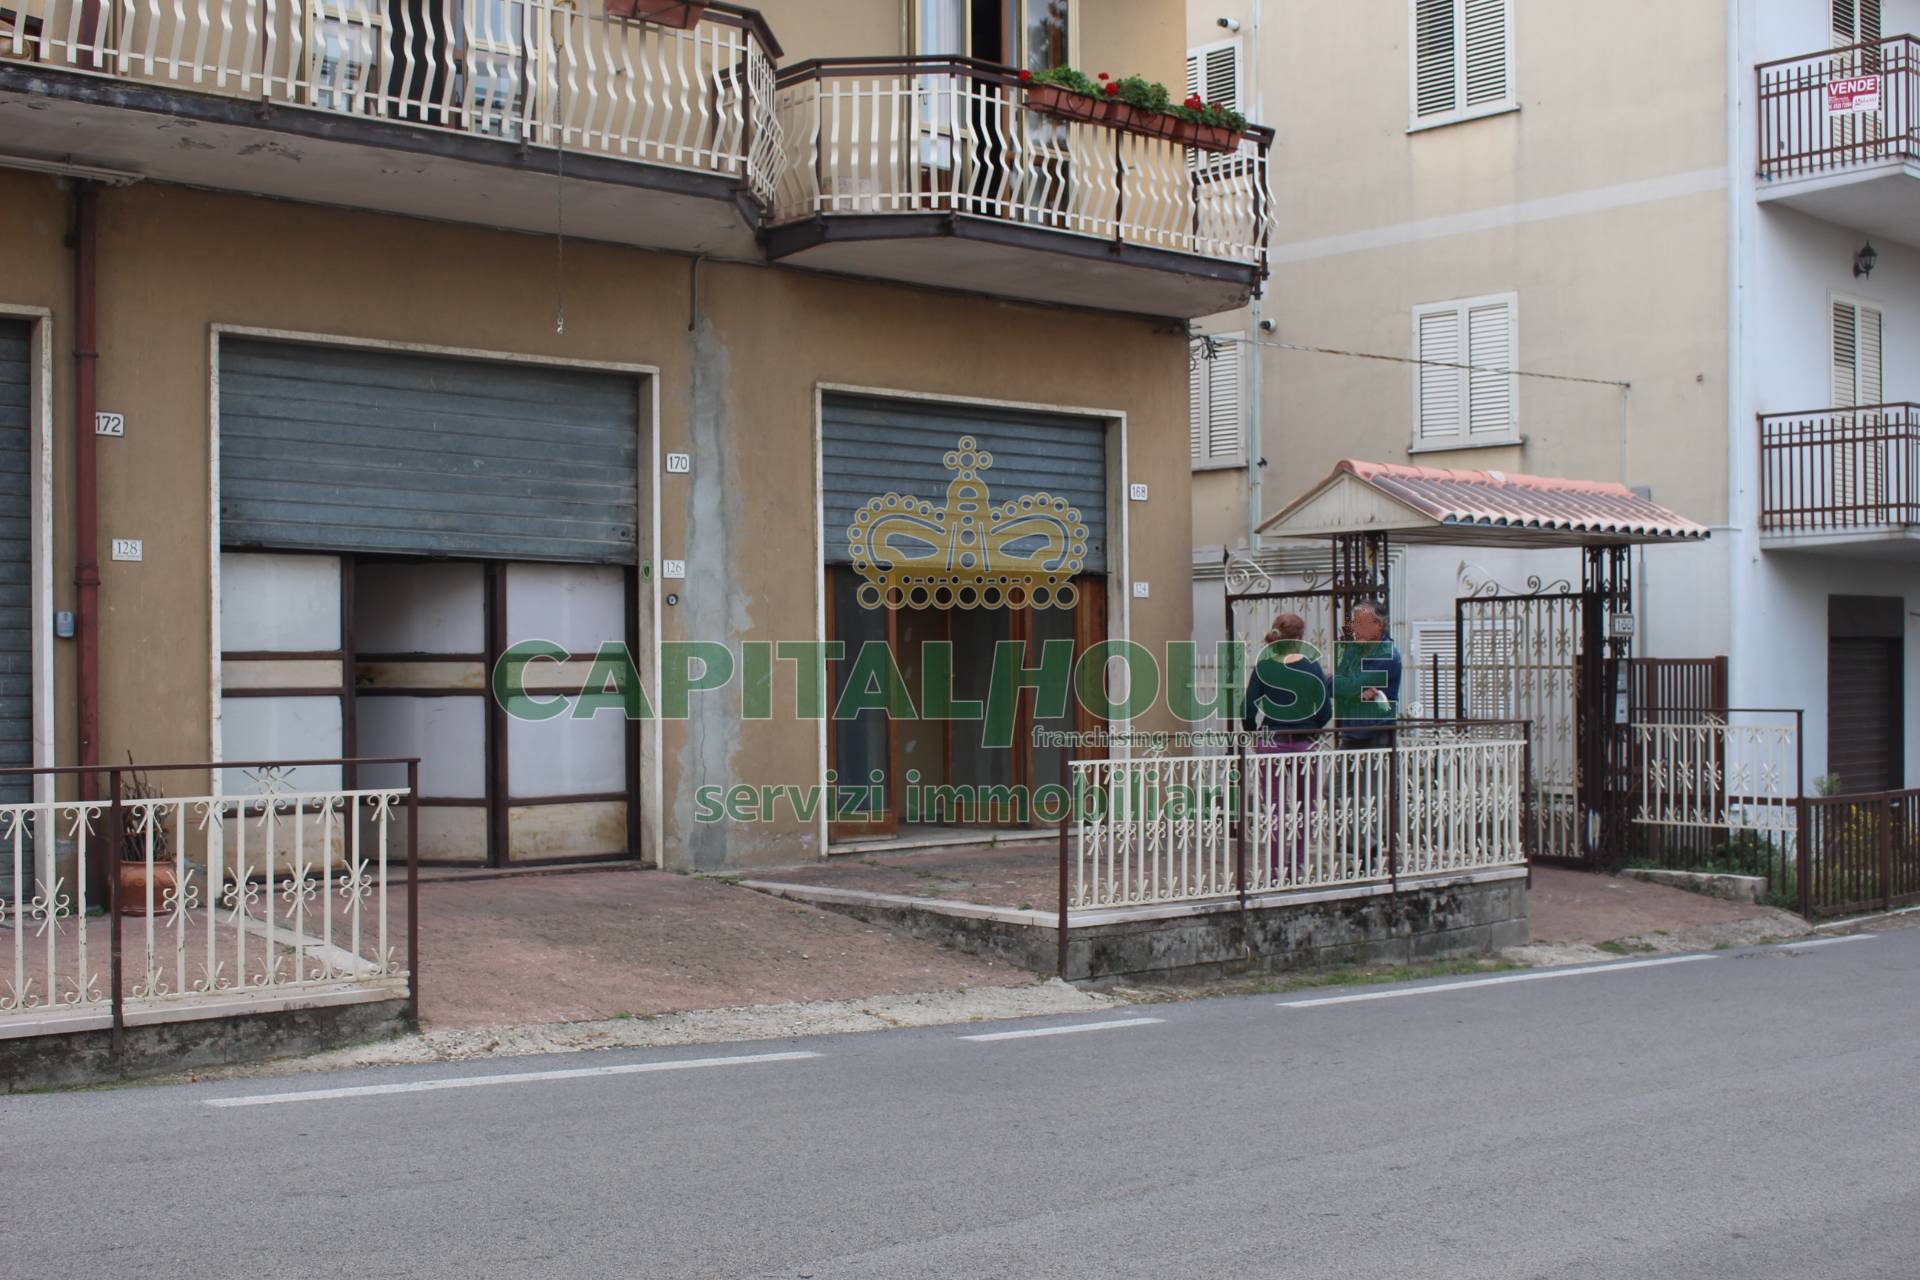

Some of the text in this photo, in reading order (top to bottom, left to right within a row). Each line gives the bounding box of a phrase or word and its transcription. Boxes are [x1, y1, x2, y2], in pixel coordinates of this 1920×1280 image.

[1829, 78, 1876, 96] VENDE
[96, 415, 121, 433] 172
[669, 455, 688, 471] 170
[1132, 486, 1146, 498] 168
[117, 541, 138, 555] 128
[666, 561, 682, 573] 126
